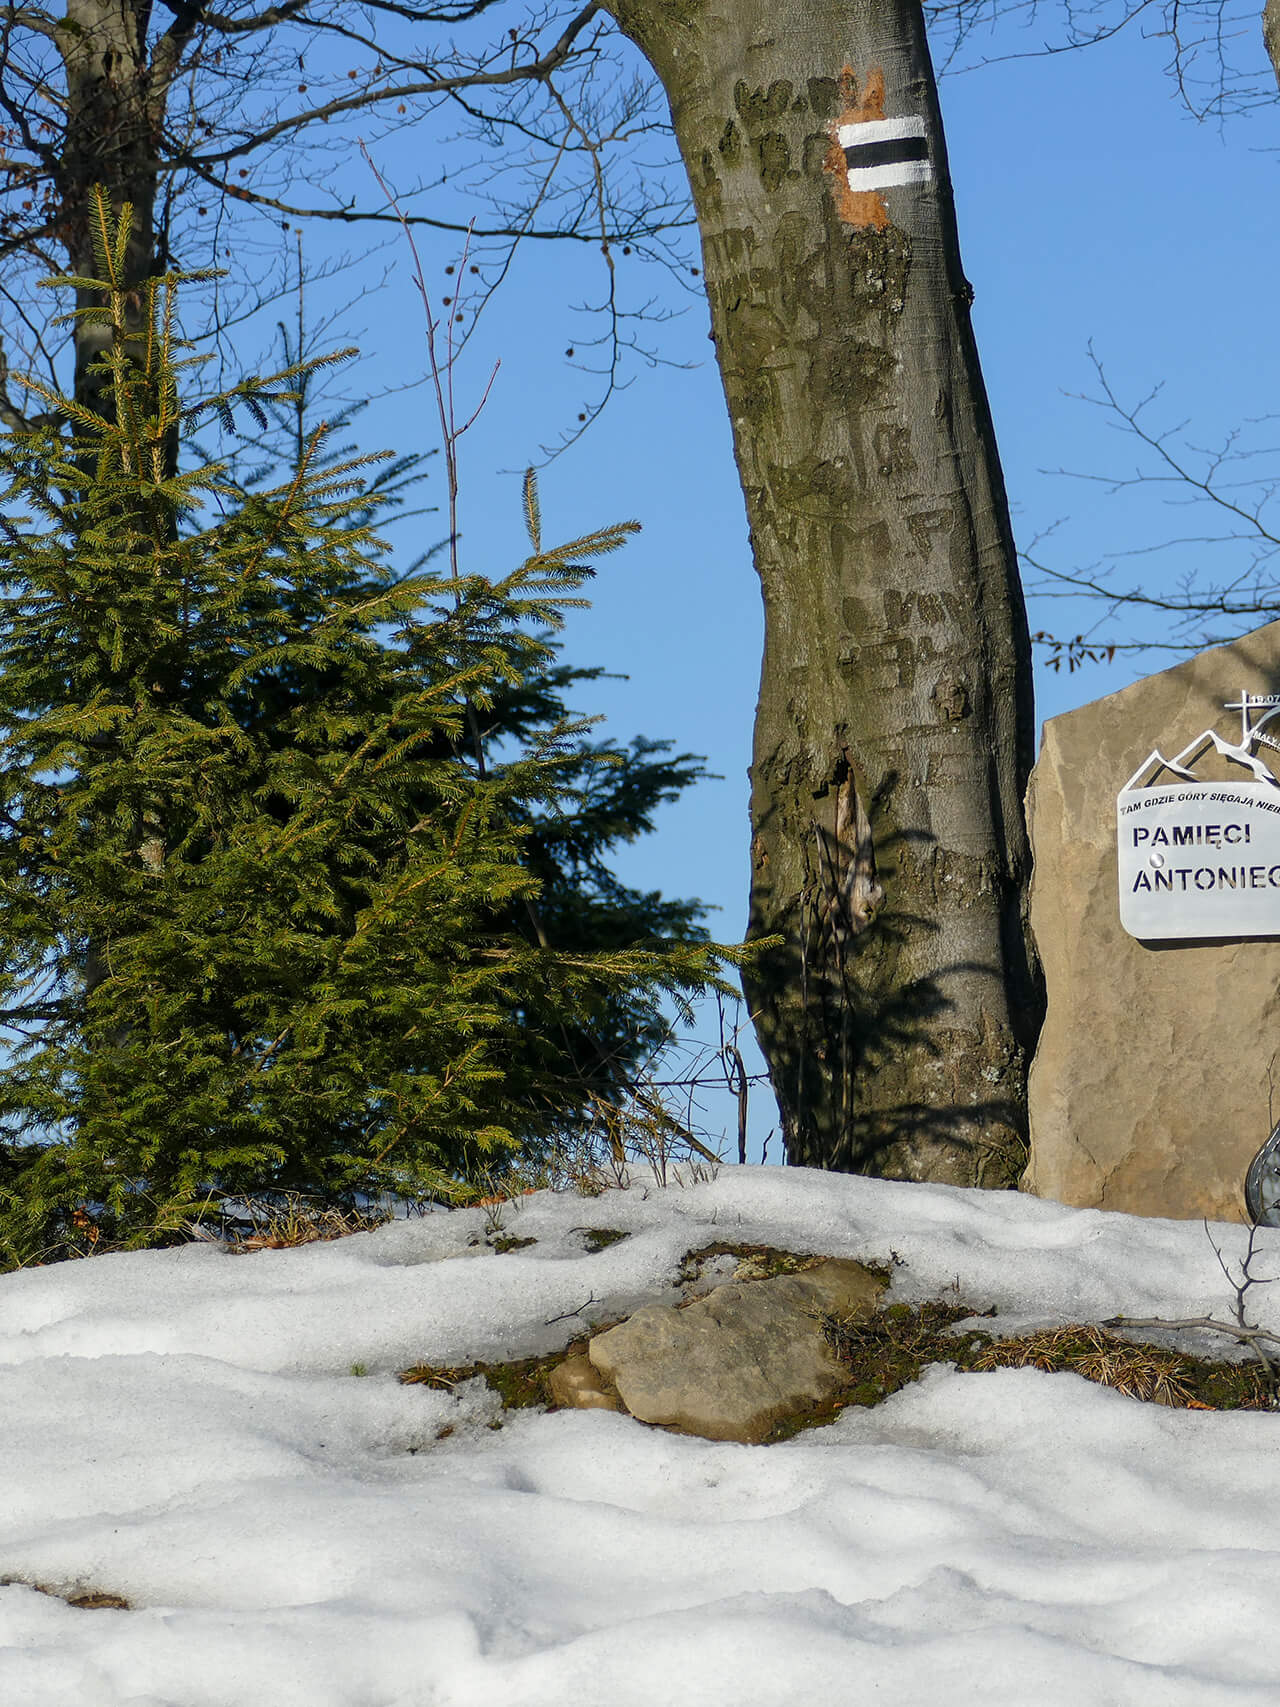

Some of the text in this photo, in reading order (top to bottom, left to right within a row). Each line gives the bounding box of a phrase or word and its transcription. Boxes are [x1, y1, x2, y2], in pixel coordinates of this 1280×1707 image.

[1120, 802, 1142, 816] TAM
[1144, 794, 1175, 808] GDZIE
[1178, 792, 1208, 802] GÓRY
[1209, 793, 1254, 808] SIĘGAJĄ
[1133, 824, 1251, 849] PAMIĘCI
